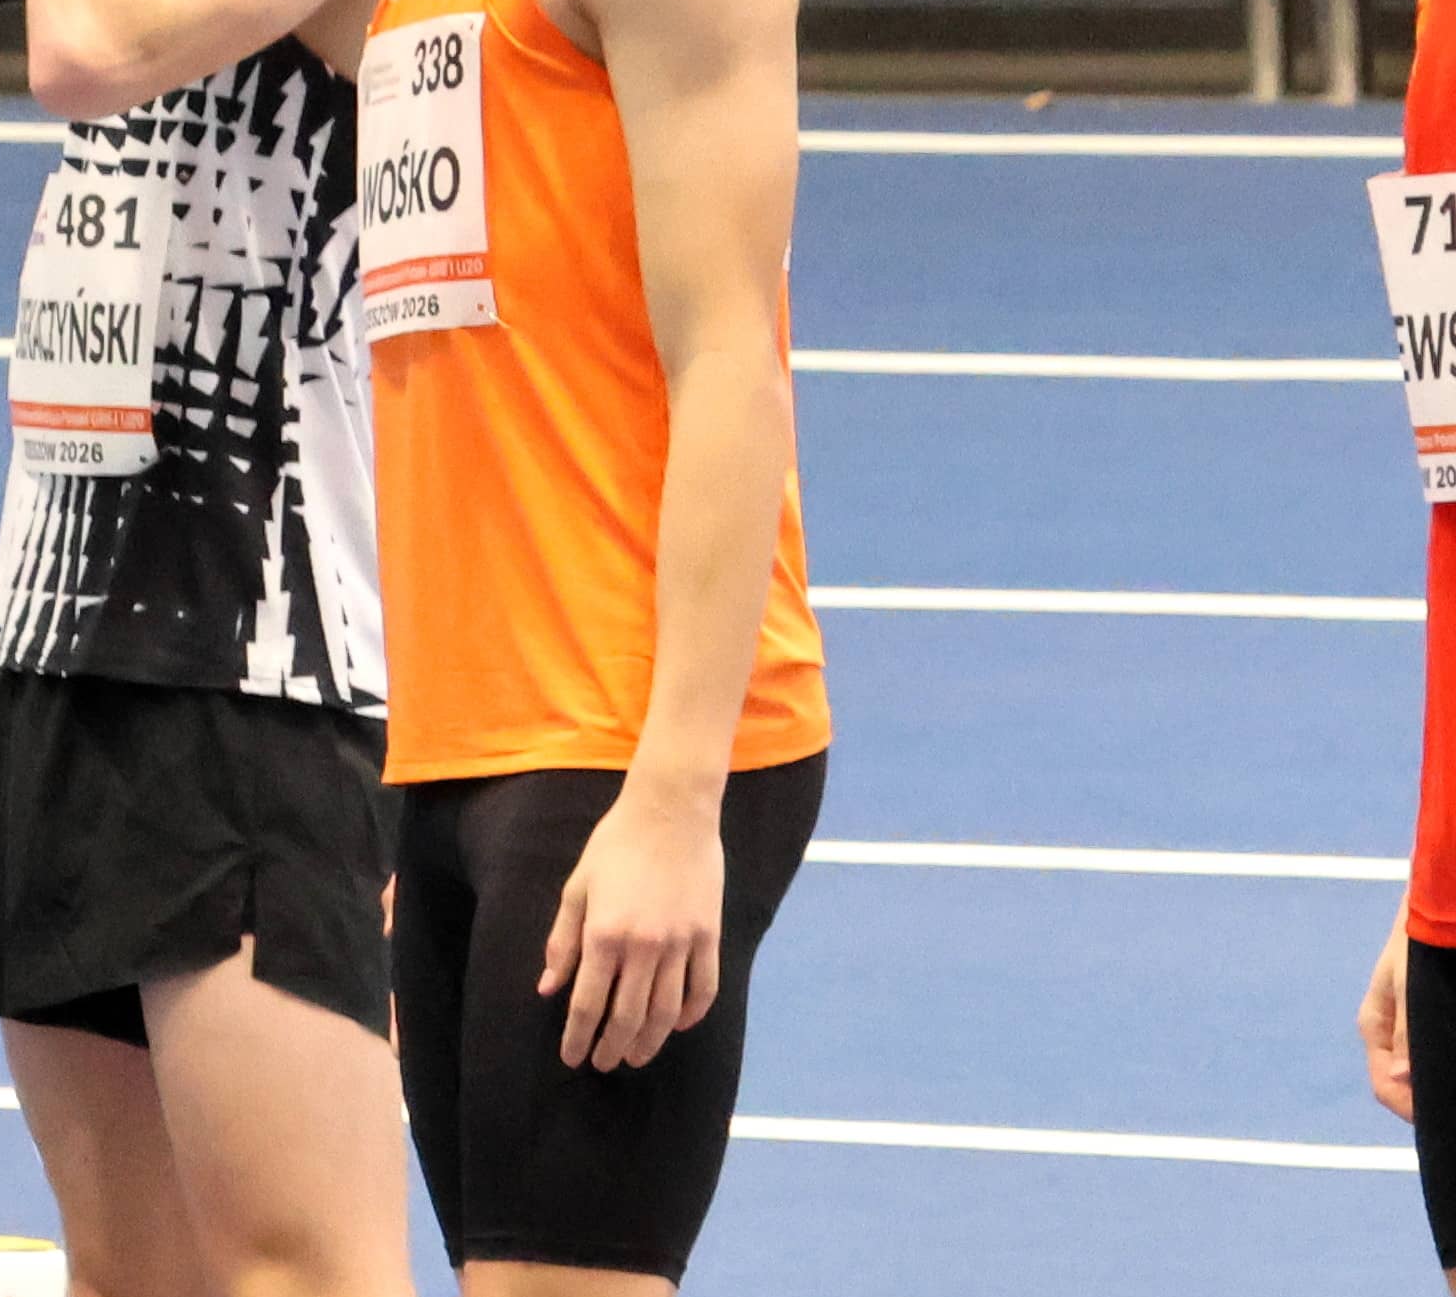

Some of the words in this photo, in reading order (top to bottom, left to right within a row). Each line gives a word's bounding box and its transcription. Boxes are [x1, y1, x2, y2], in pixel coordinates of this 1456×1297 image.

[411, 32, 464, 97] 338
[362, 138, 461, 232] WOŚKO
[56, 193, 141, 249] 481
[401, 293, 440, 320] 2026
[59, 440, 104, 464] 2026
